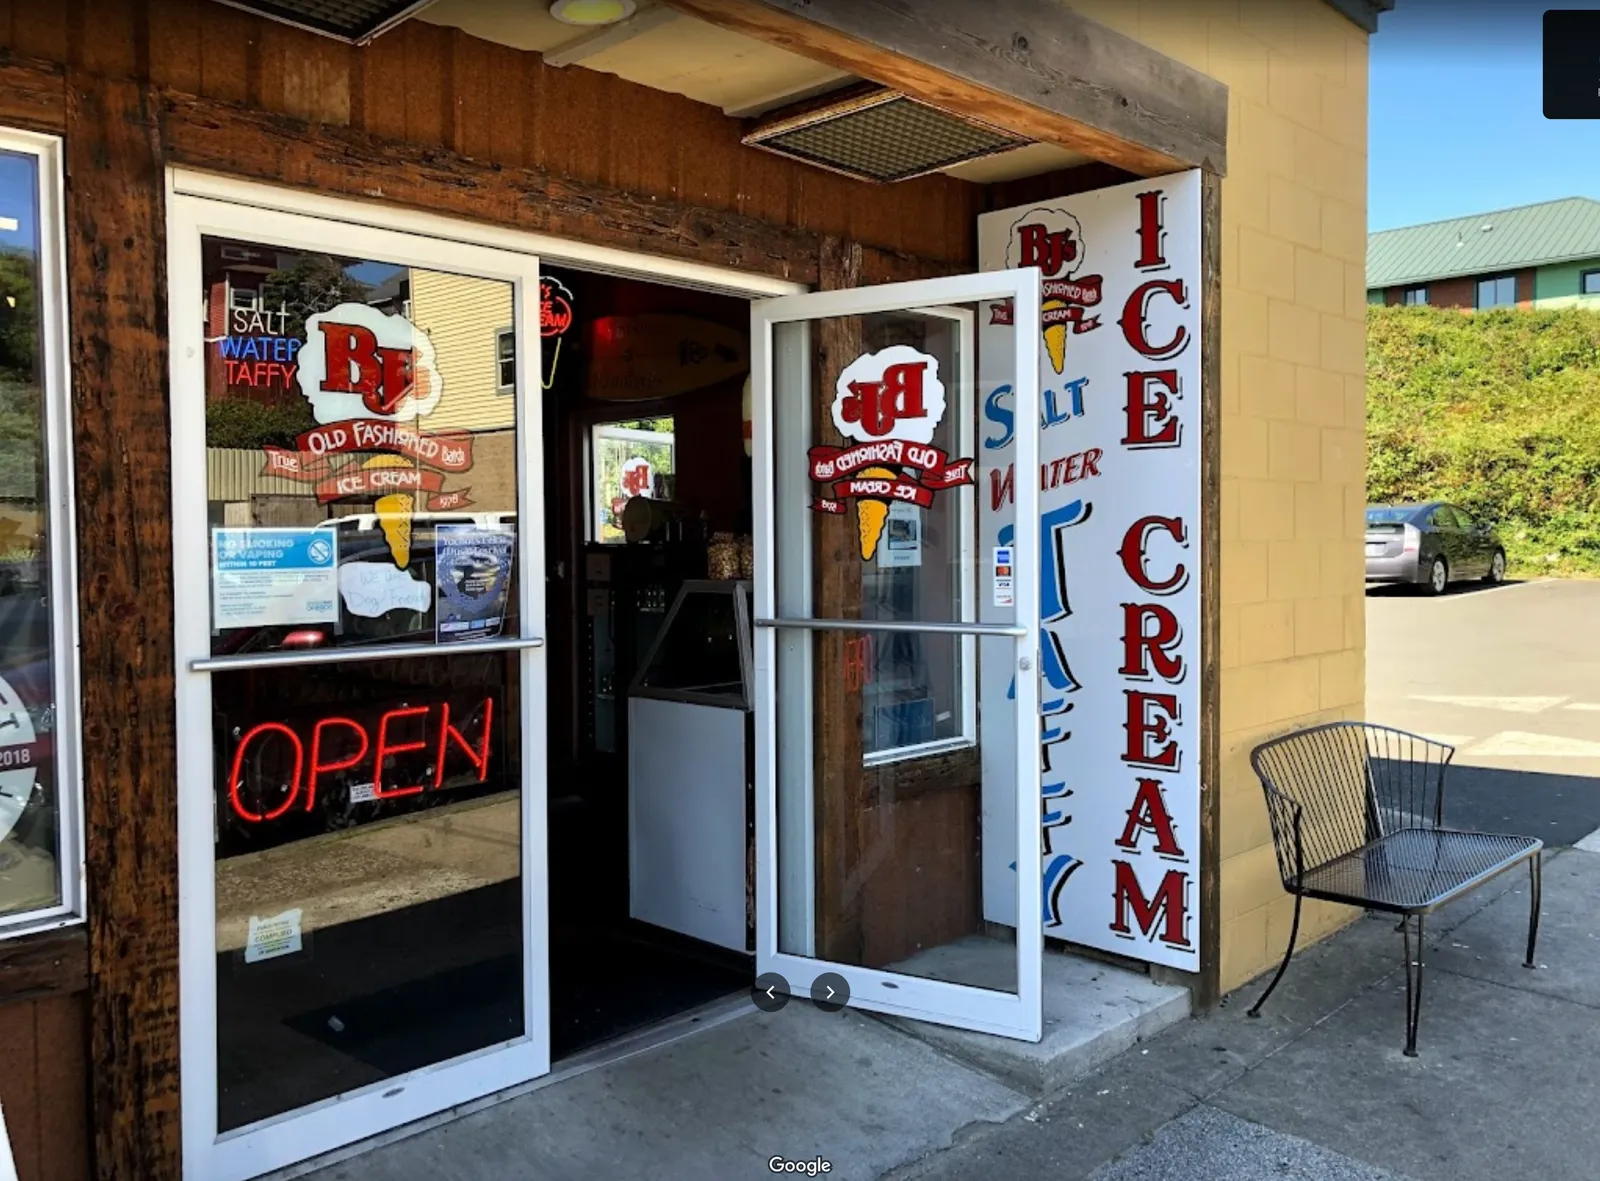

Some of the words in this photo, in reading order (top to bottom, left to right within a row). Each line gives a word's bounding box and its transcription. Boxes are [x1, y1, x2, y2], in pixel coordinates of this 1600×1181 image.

[1041, 282, 1081, 299] SHIONED
[232, 300, 291, 336] SALT
[540, 313, 567, 327] EAM
[1043, 309, 1071, 322] CREAM
[1116, 190, 1191, 450] ICE
[224, 361, 298, 390] TAFFY
[984, 377, 1090, 449] SLT
[308, 429, 347, 455] OLD
[352, 421, 439, 459] FASHIONED
[268, 450, 299, 472] True
[336, 475, 365, 494] ICE
[370, 471, 421, 486] CREAM
[989, 448, 1103, 512] WTER
[238, 549, 284, 559] VAPING
[240, 538, 295, 549] SMOKING
[1109, 515, 1195, 953] CREAM
[229, 697, 493, 822] OPEN
